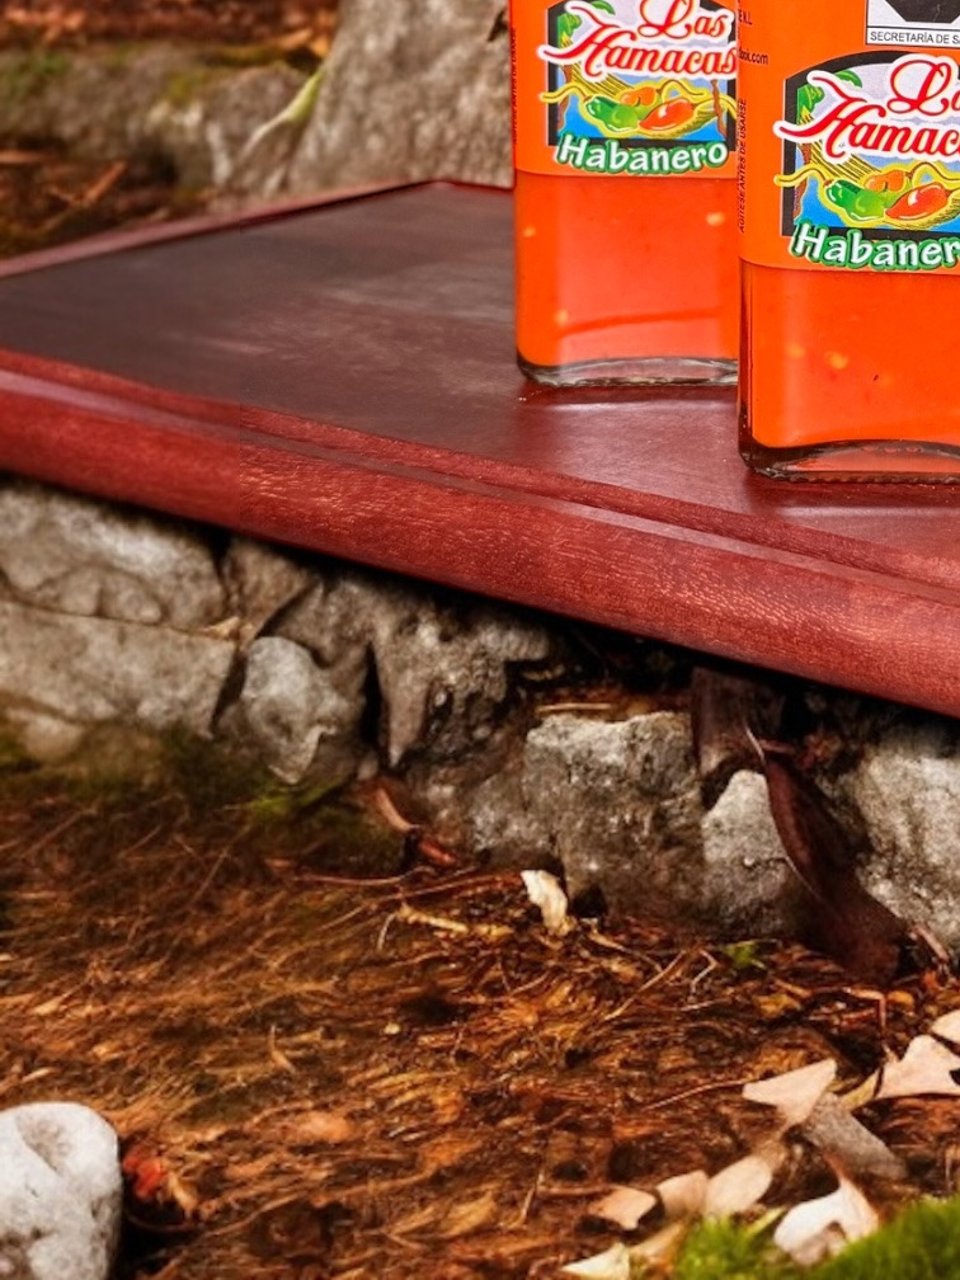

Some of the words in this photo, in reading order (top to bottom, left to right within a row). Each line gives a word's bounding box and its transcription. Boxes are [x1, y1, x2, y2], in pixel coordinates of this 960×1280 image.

[543, 5, 737, 77] Hamacas
[870, 31, 933, 44] SECRETARÍA
[936, 34, 950, 44] DE
[559, 133, 729, 171] Habanero
